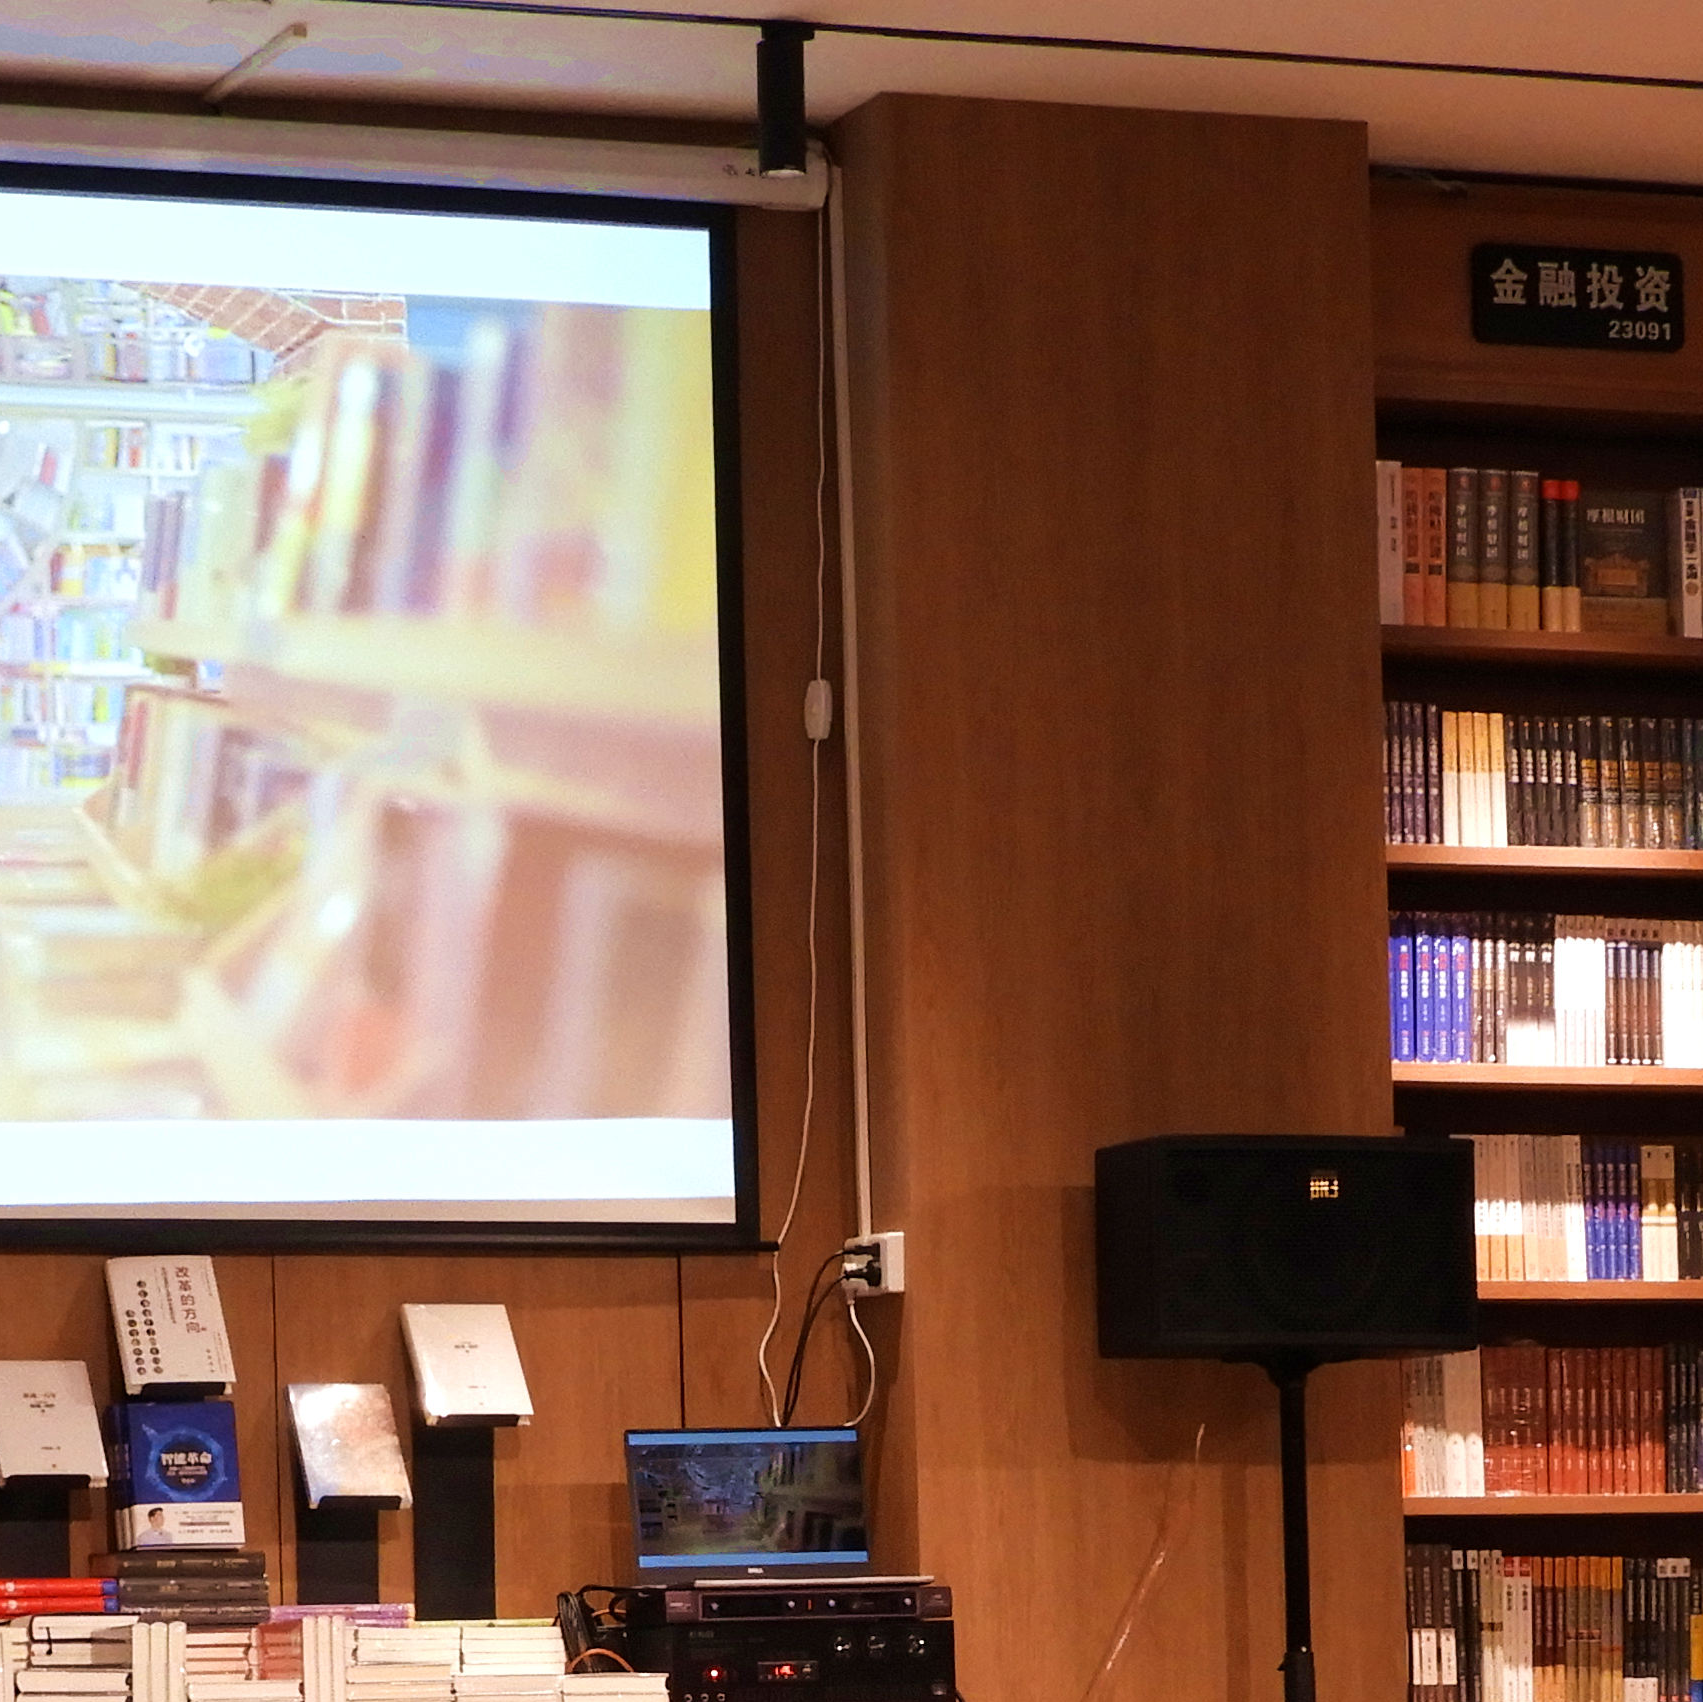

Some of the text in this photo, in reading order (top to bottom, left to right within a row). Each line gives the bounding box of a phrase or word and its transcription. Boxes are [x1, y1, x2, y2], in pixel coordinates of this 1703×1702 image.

[1490, 258, 1674, 315] 金融投资
[1608, 318, 1673, 343] 23091
[174, 1266, 201, 1334] 改革的方向
[160, 1451, 213, 1466] 智能革命
